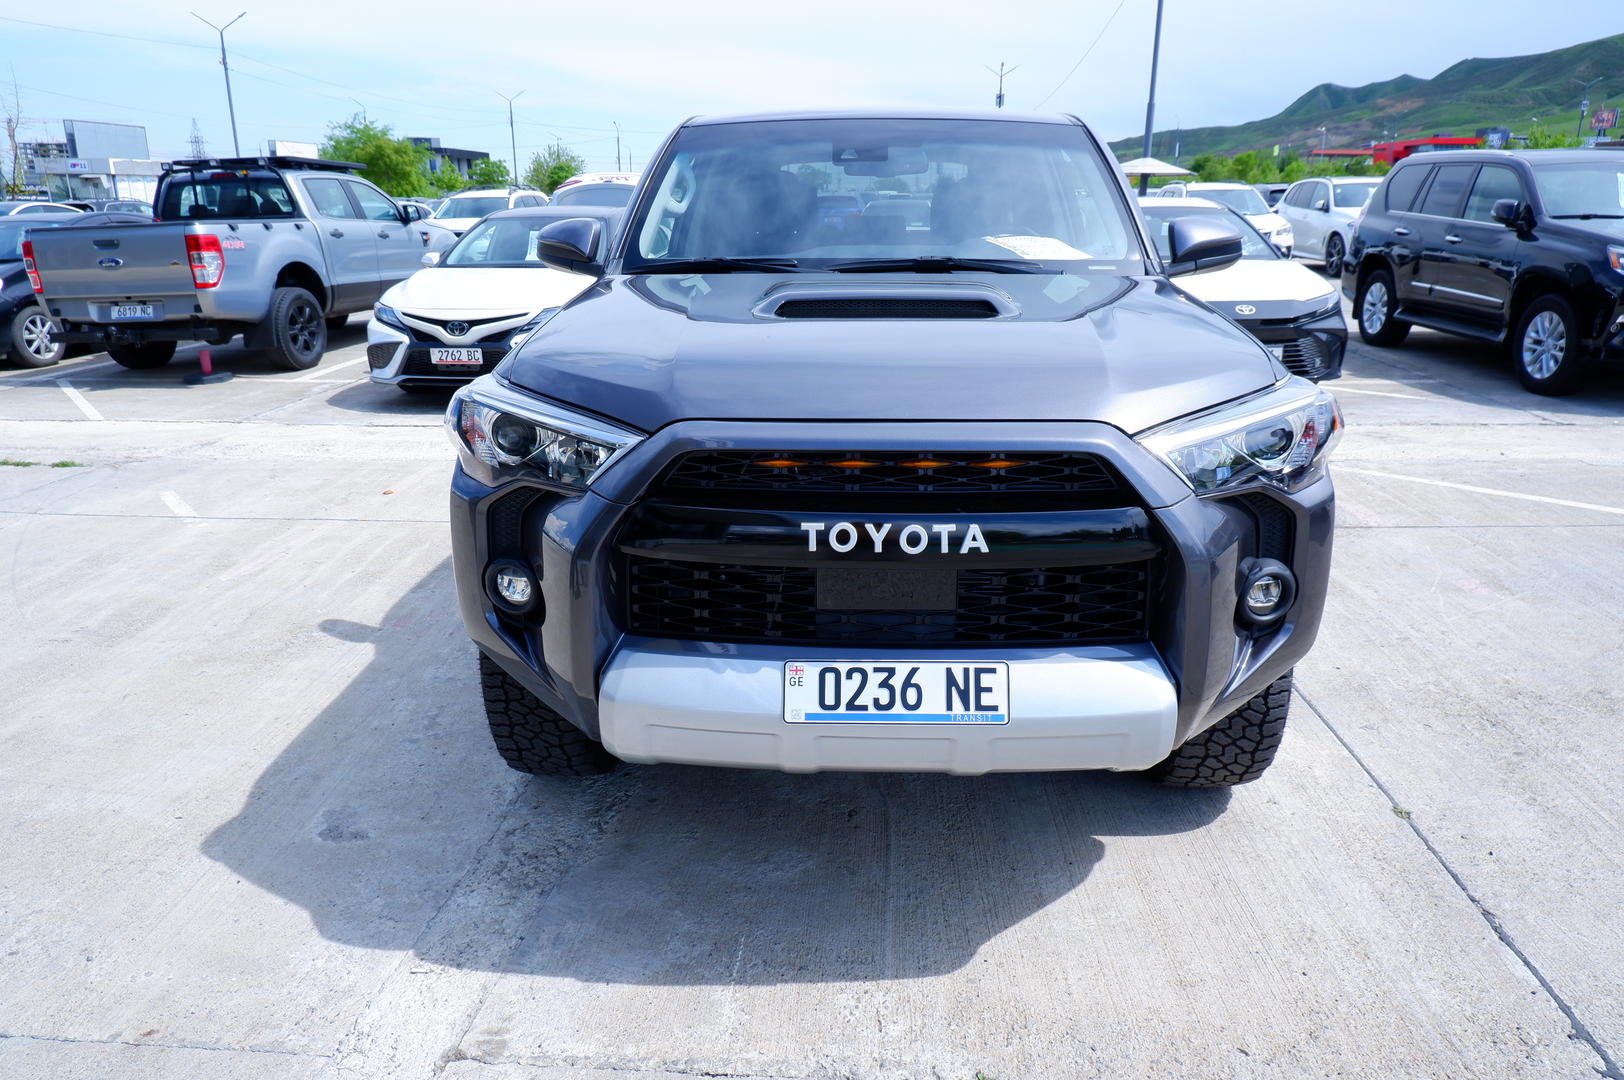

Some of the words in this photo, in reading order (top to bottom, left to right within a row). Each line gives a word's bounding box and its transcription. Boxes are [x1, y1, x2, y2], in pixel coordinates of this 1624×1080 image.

[117, 306, 137, 317] 6819
[140, 306, 151, 316] NC
[438, 350, 462, 361] 2762
[466, 350, 480, 361] BC
[800, 521, 990, 555] TOYOTA
[789, 676, 804, 687] GE
[818, 666, 923, 712] 0236
[945, 667, 999, 712] NE
[950, 714, 993, 722] TRANSIT
